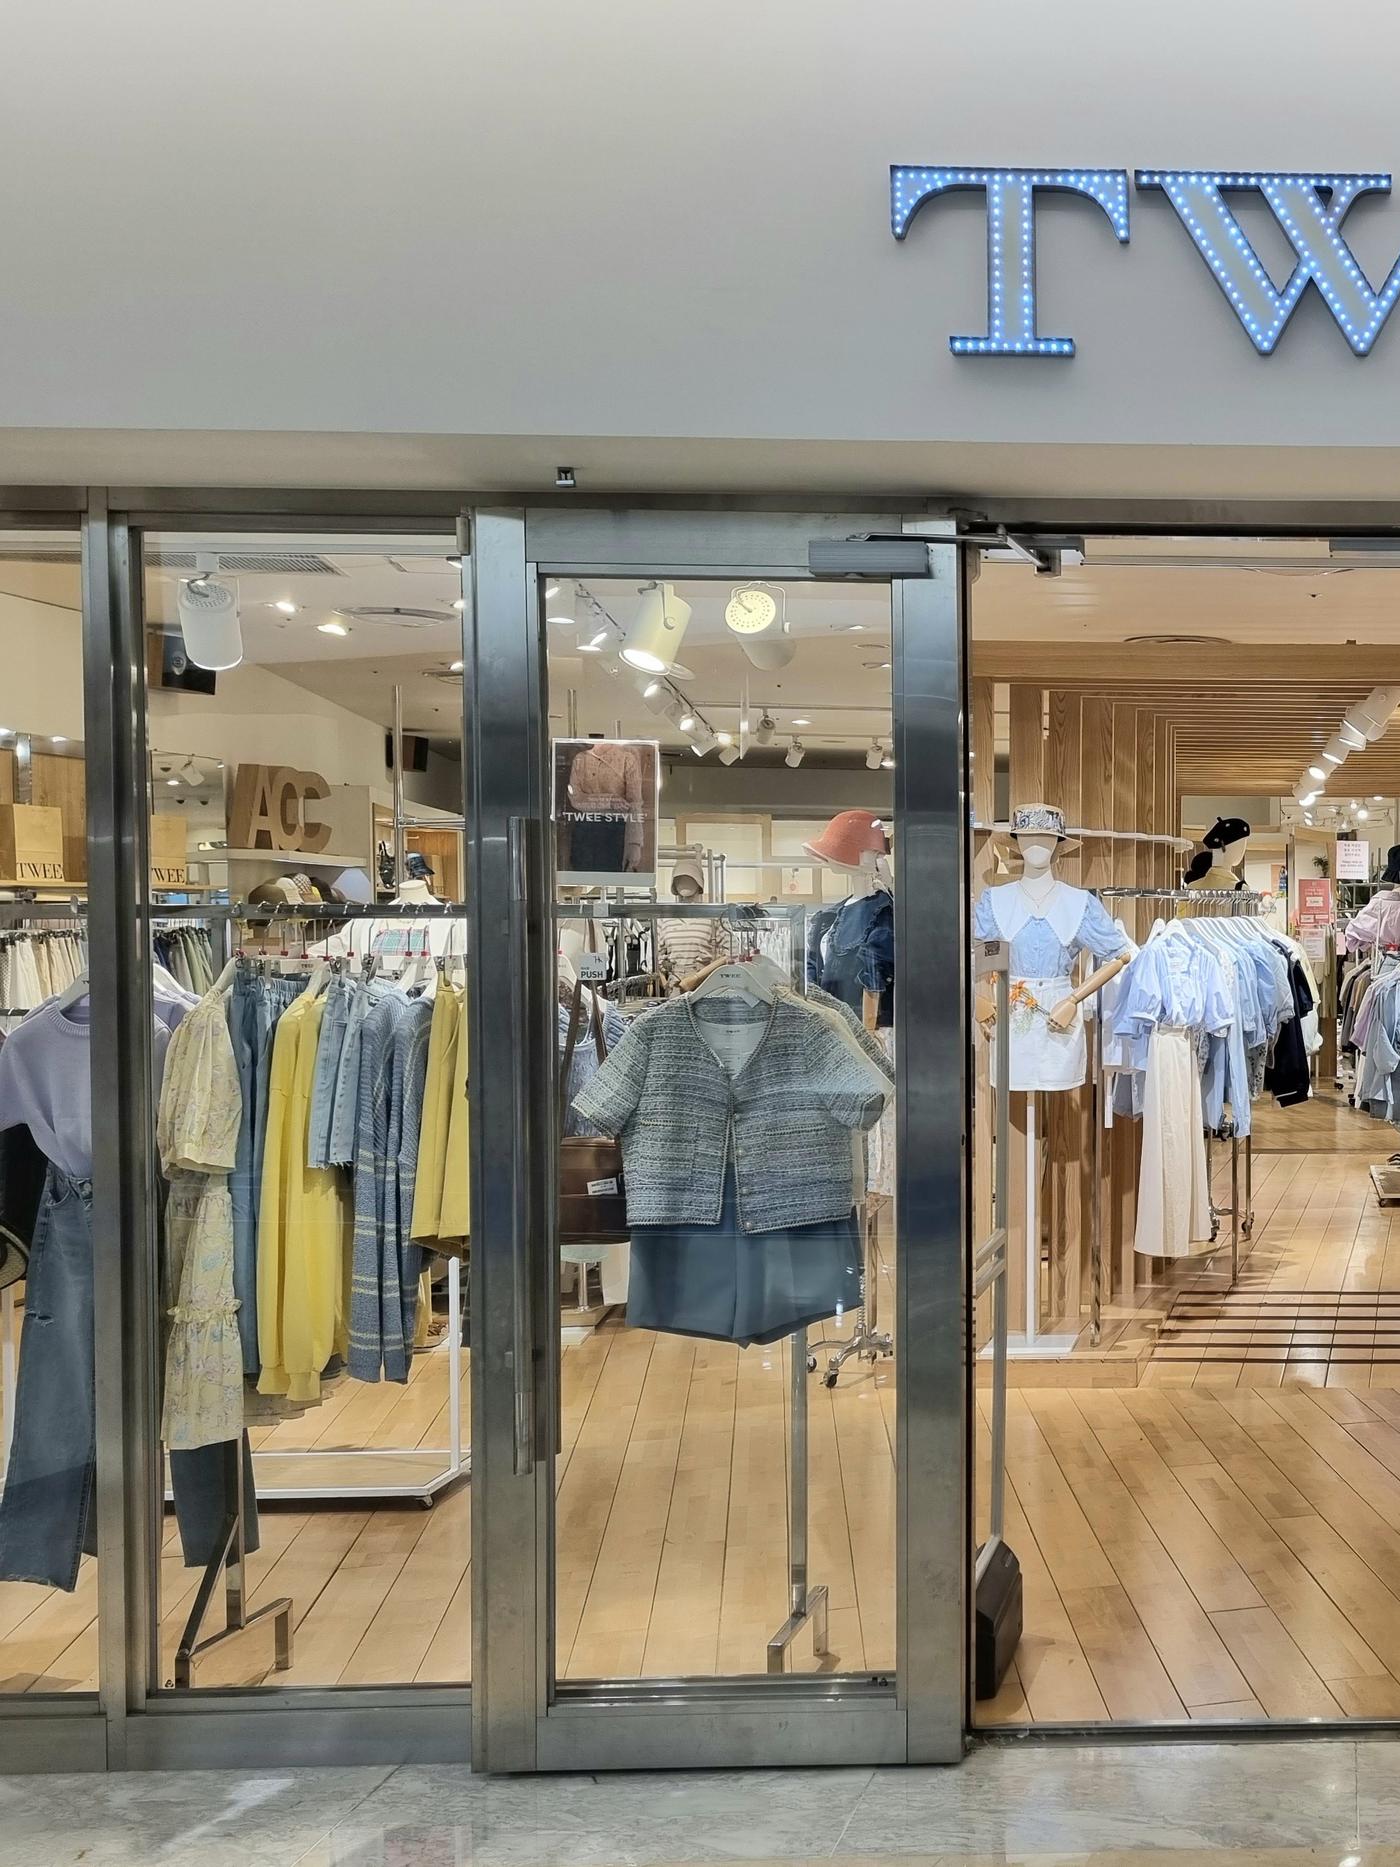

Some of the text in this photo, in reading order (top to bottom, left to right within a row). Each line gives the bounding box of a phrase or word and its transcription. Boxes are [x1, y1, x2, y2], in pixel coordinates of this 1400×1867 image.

[16, 863, 63, 879] TWEE
[152, 867, 185, 884] WEE
[580, 970, 604, 979] PUSH
